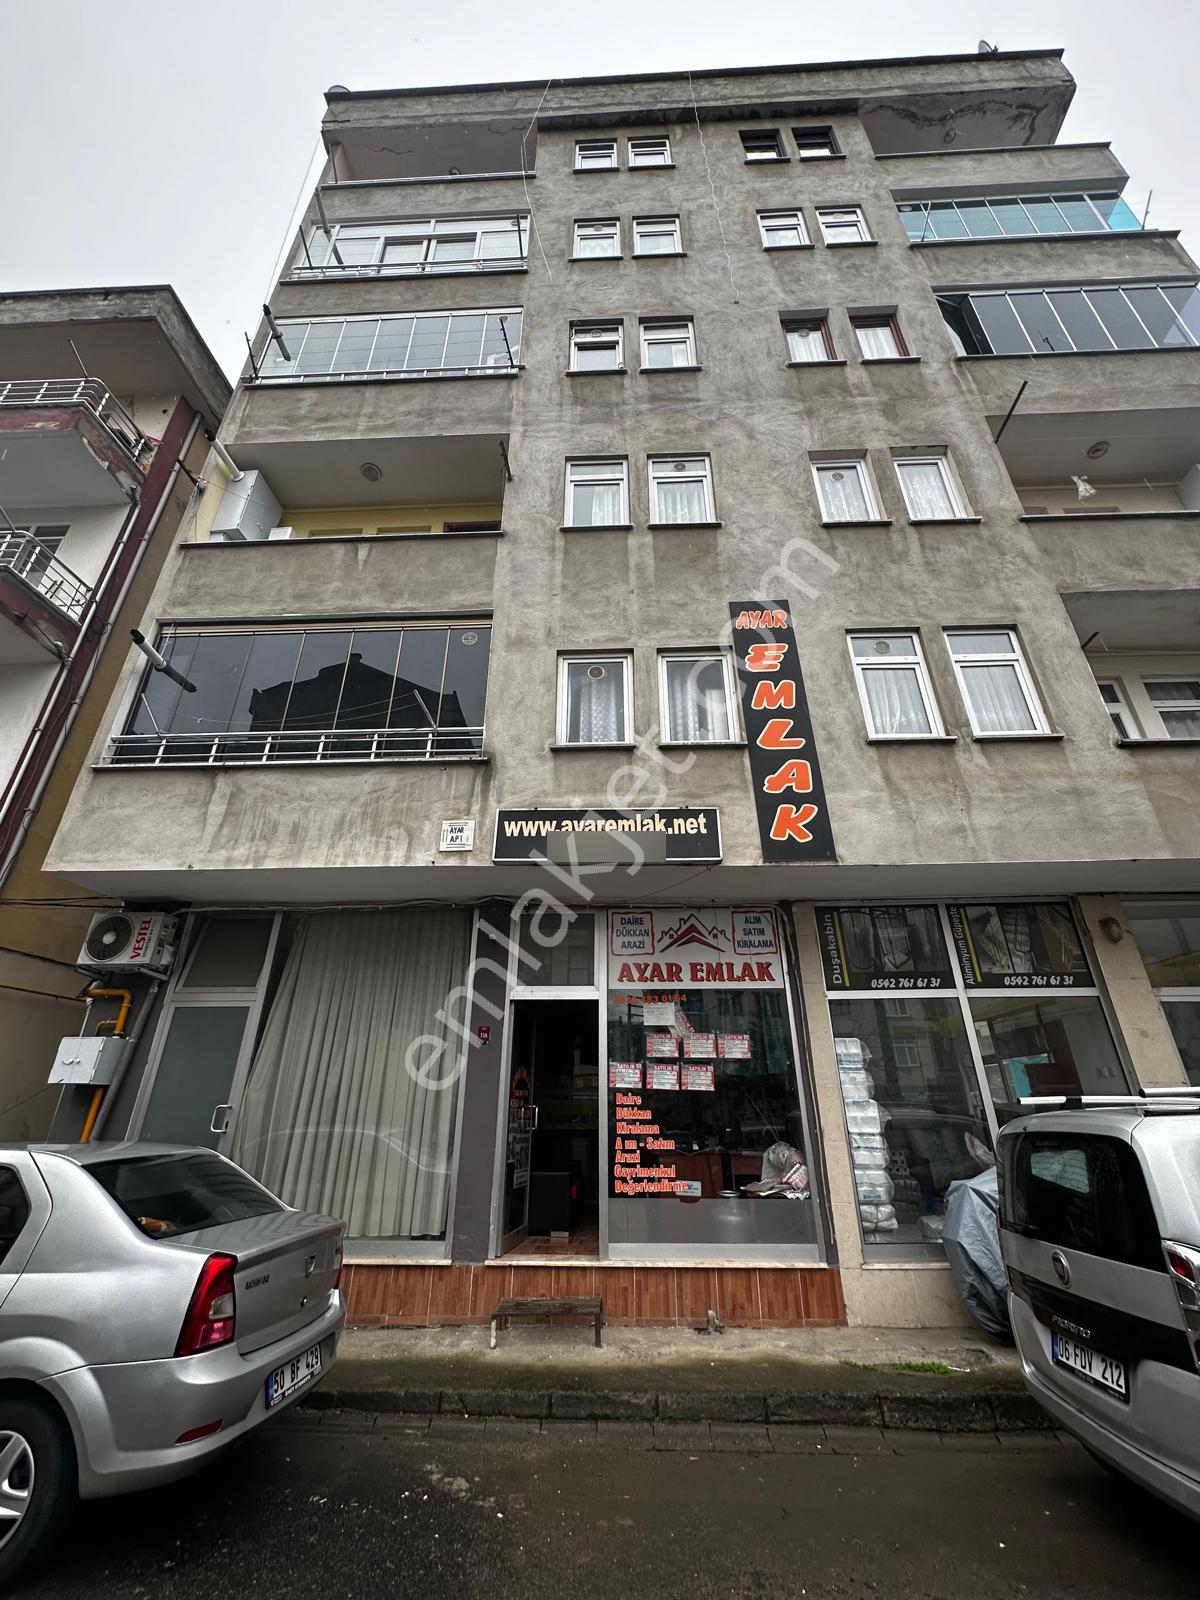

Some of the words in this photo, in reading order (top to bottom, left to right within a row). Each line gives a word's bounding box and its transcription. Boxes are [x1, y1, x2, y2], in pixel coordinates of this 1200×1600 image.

[735, 609, 788, 630] AYAR
[745, 642, 818, 842] EMLAK
[449, 826, 465, 834] AYAR
[620, 917, 645, 926] DAİRE
[744, 915, 762, 925] ALIM
[616, 927, 650, 937] DÜKKAN
[742, 927, 765, 937] SATIM
[130, 918, 153, 960] VESTEL
[620, 939, 645, 949] ARAZİ
[736, 938, 774, 949] KİRALAMA
[824, 914, 842, 984] Duşakabin
[617, 961, 684, 983] AYAR
[689, 961, 776, 983] EMLAK
[870, 978, 896, 989] 0542
[898, 977, 915, 988] 761
[916, 977, 928, 988] 61
[929, 977, 941, 988] 31
[1003, 975, 1030, 986] 0542
[1031, 975, 1048, 986] 761
[1049, 975, 1061, 986] 61
[1063, 975, 1074, 986] 31
[615, 1092, 642, 1105] Daire
[616, 1107, 652, 1119] Dükkan
[646, 1137, 675, 1150] Satım
[615, 1150, 640, 1163] Arazi
[614, 1164, 676, 1183] Gayrimenkul
[614, 1179, 688, 1195] Değerlendirme
[273, 1369, 285, 1394] 50
[290, 1357, 301, 1383] BF
[305, 1346, 319, 1371] 429
[1058, 1337, 1070, 1361] 06
[1073, 1343, 1094, 1374] FDV
[1101, 1356, 1124, 1390] 212
